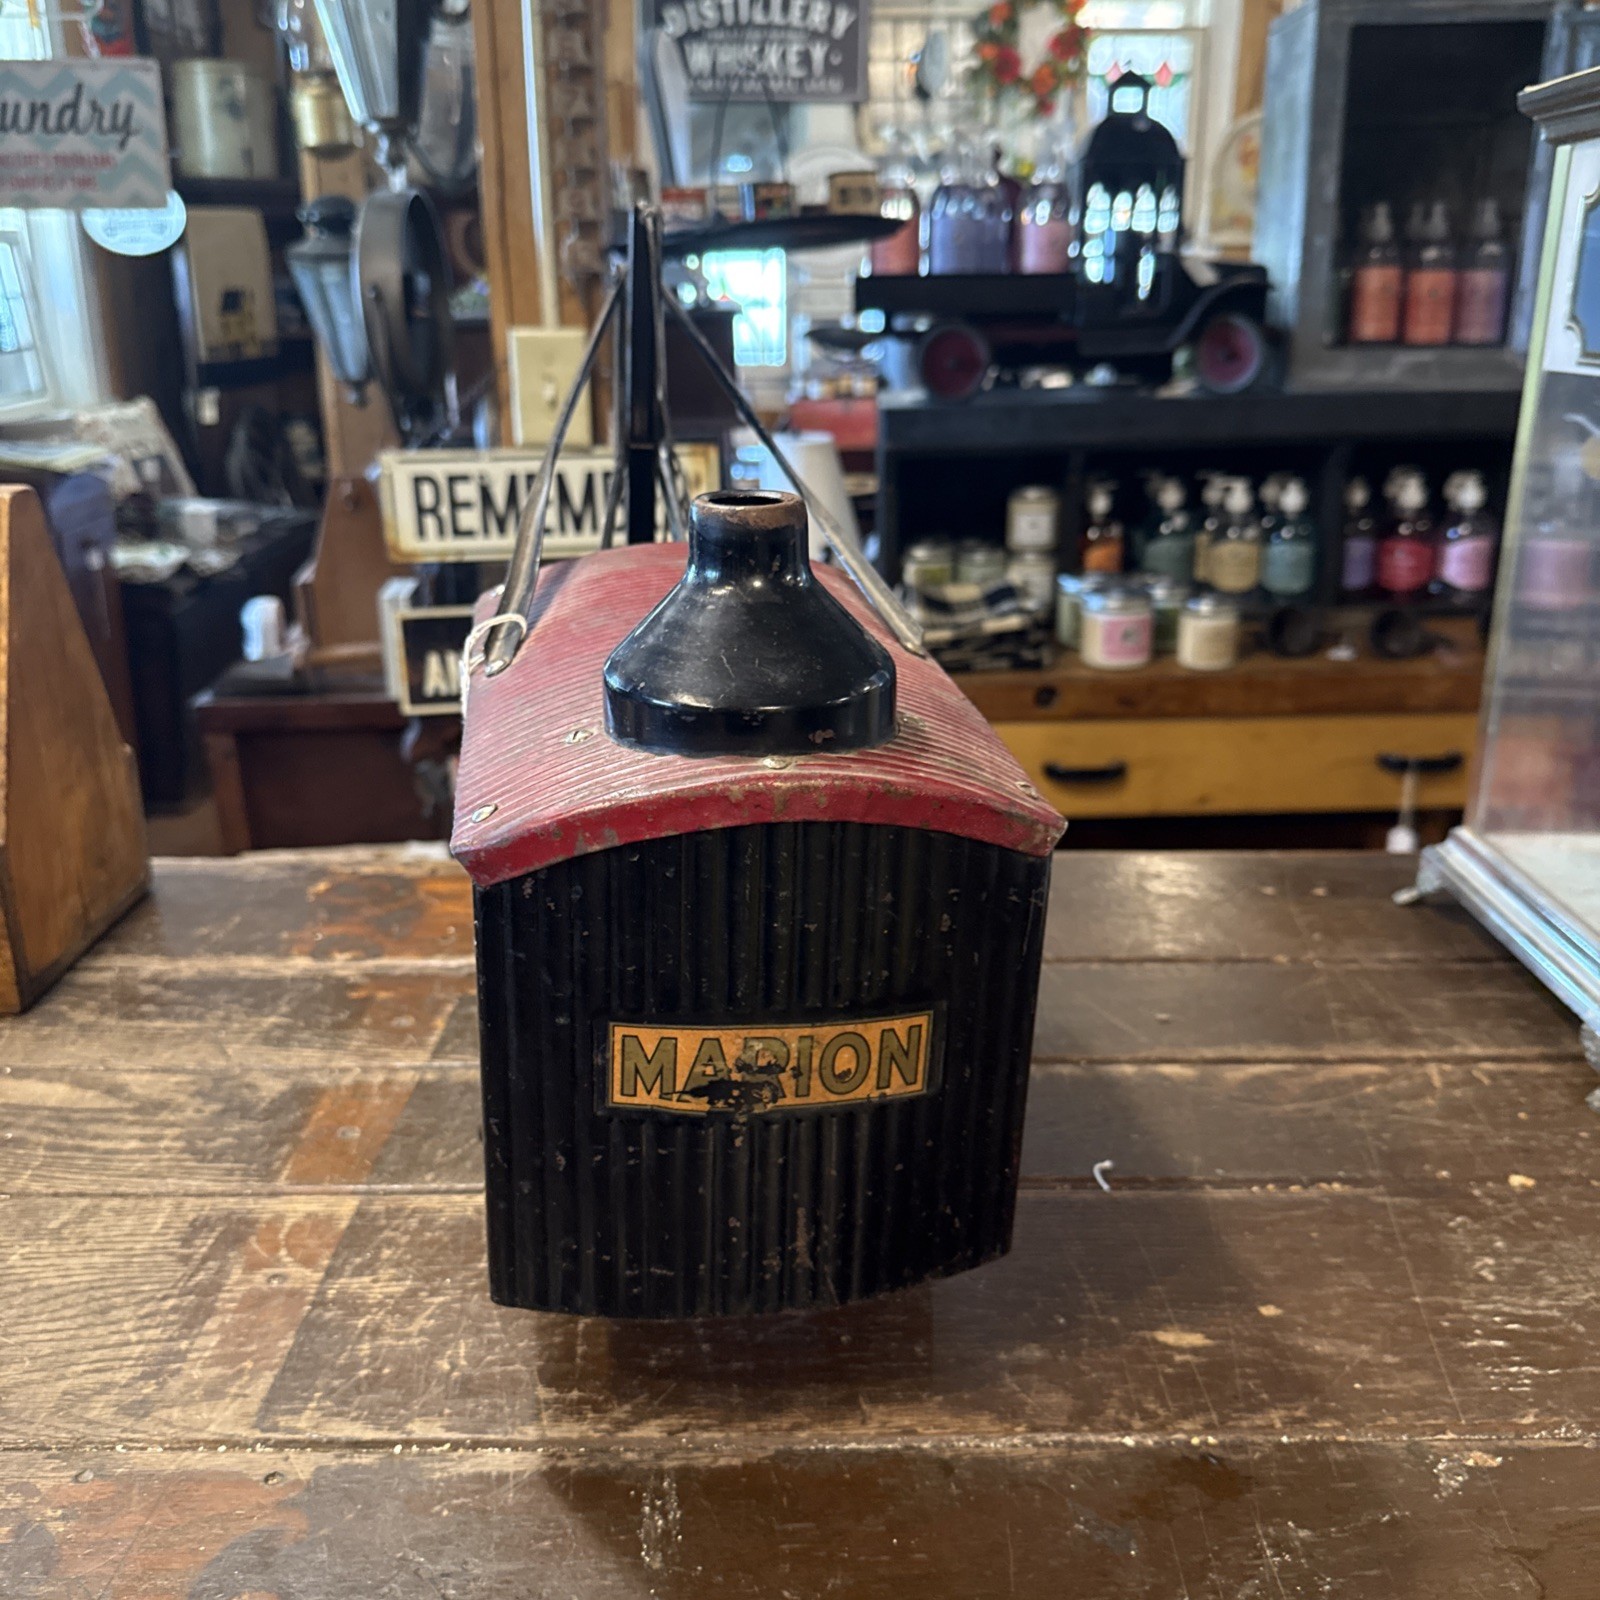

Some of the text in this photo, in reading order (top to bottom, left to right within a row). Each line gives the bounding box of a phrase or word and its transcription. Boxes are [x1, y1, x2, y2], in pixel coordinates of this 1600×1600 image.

[662, 0, 857, 40] DISTILLERY
[684, 40, 830, 80] WHISKEY
[620, 1023, 923, 1102] MARION
